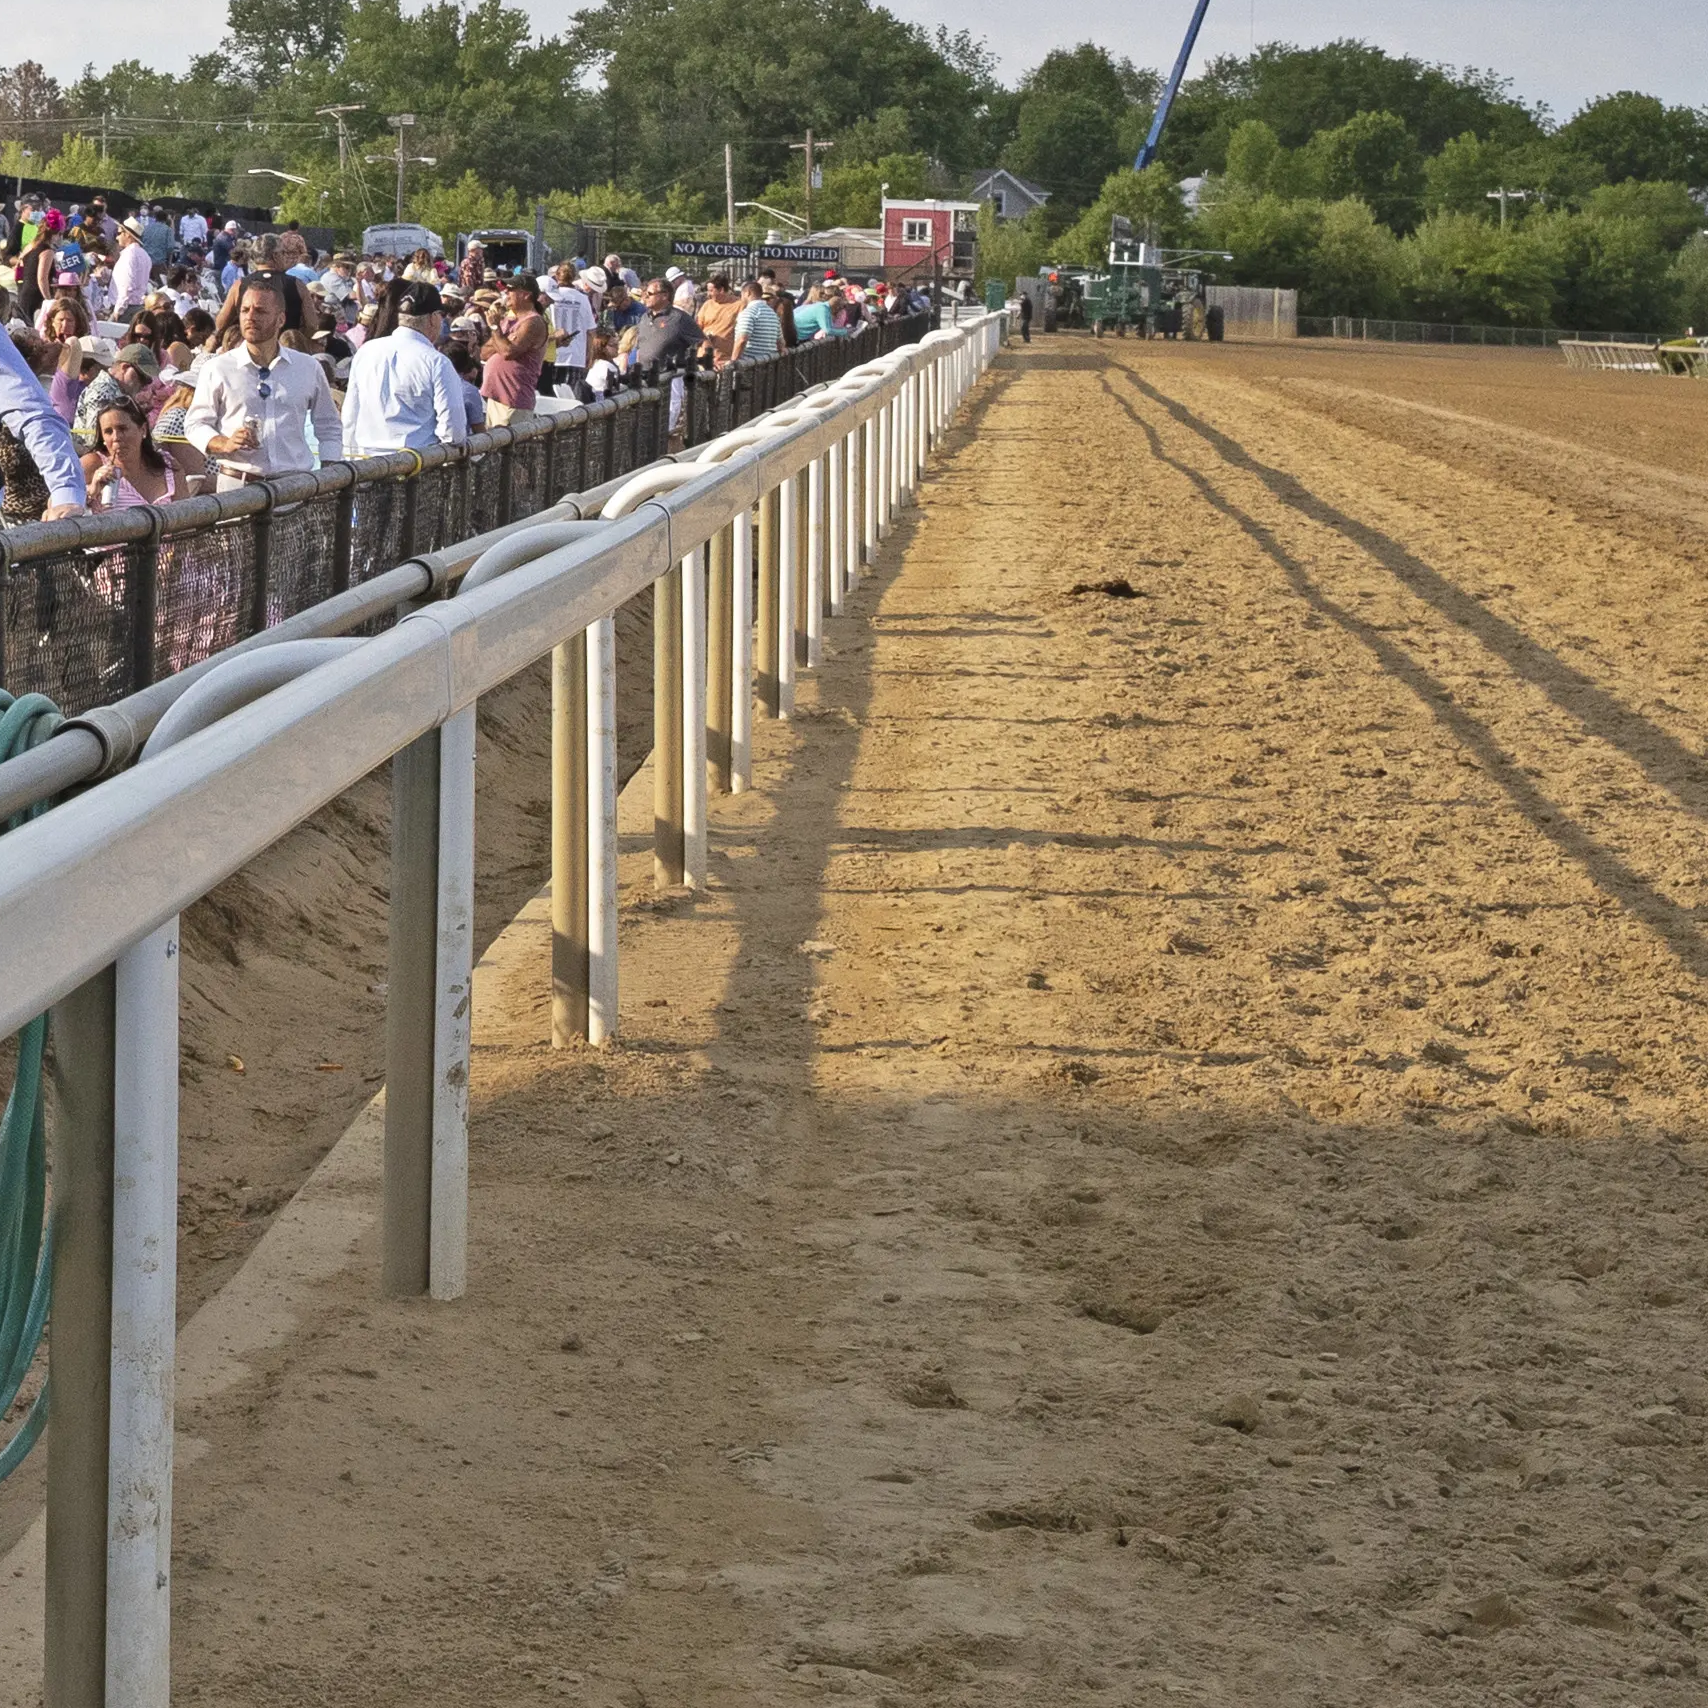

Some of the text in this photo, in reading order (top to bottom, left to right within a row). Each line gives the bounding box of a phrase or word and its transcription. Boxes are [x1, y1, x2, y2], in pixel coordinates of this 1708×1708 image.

[675, 242, 748, 256] NO ACCESS
[762, 246, 839, 260] TO INFIELD
